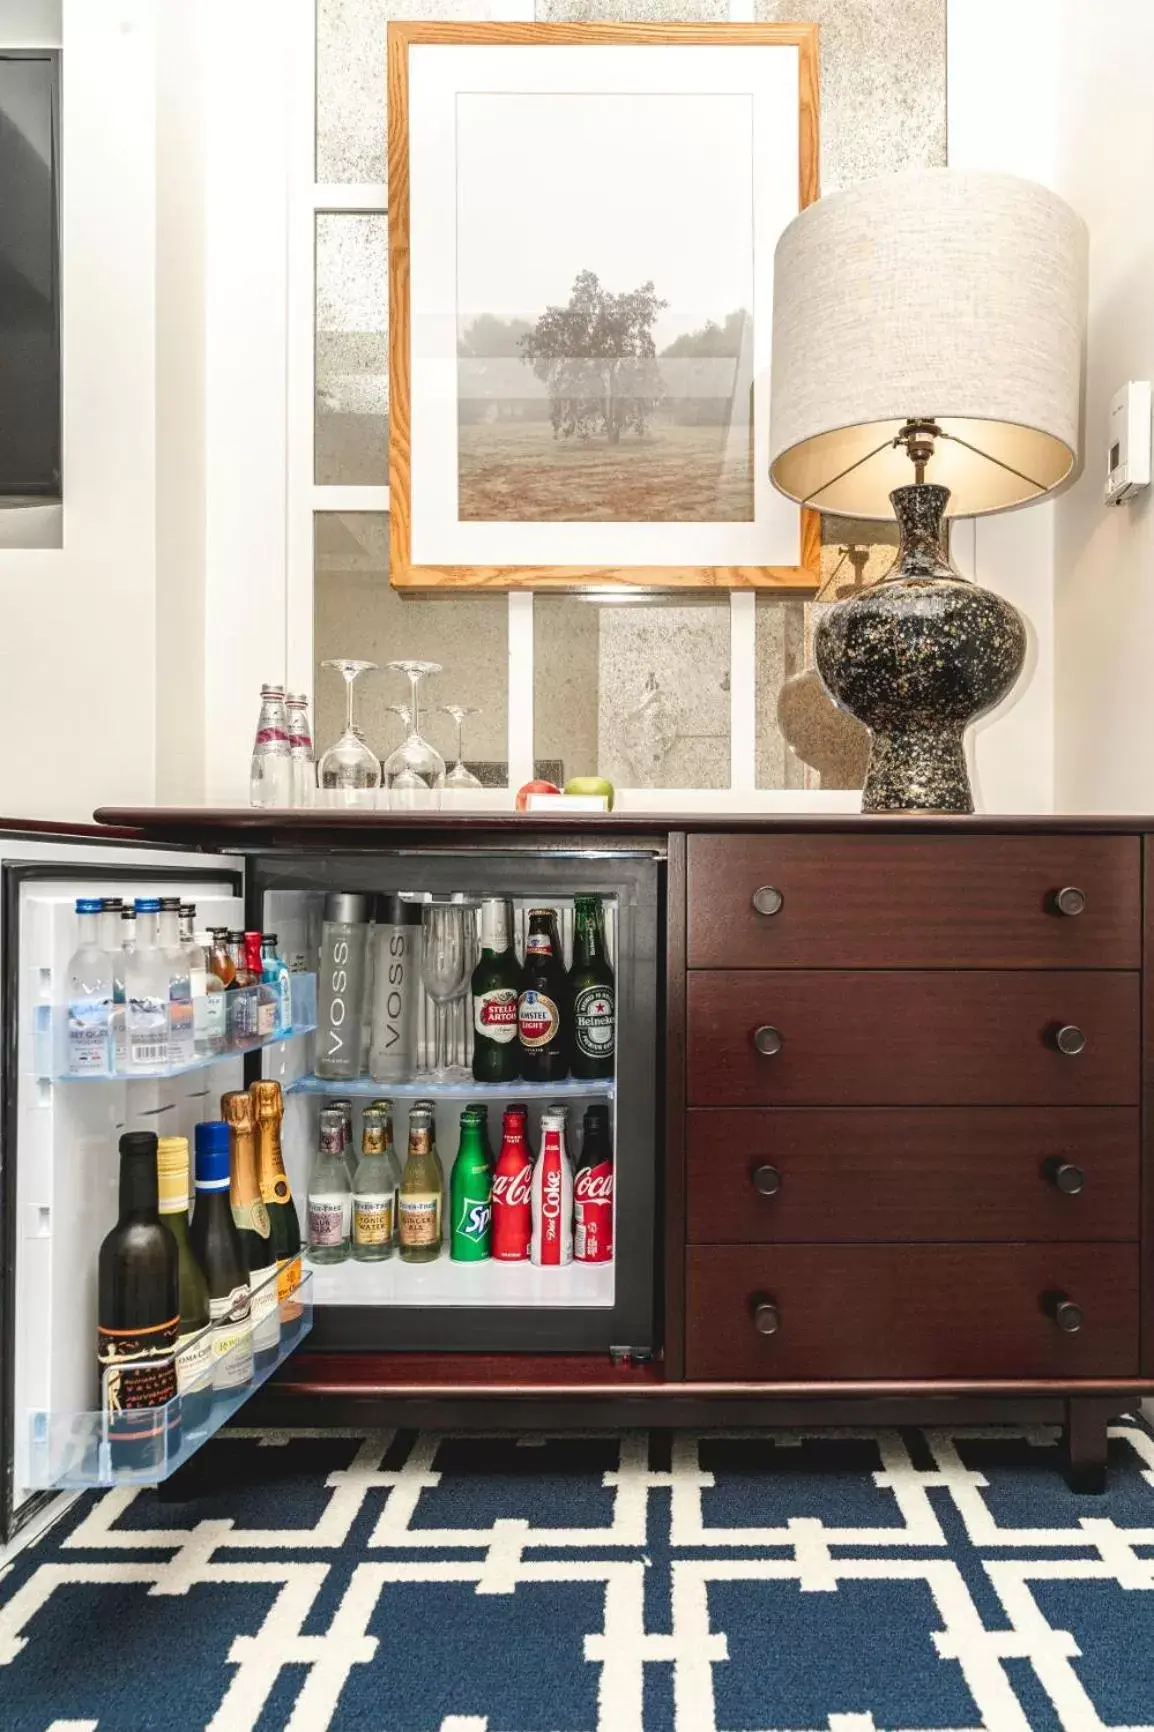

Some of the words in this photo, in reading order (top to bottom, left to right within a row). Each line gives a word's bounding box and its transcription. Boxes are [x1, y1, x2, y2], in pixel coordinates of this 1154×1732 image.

[328, 942, 349, 1055] VOSS
[385, 934, 405, 1048] VOSS
[488, 1013, 516, 1021] ARTOI
[521, 1021, 544, 1030] LIGHT
[578, 1016, 615, 1026] Heineke
[543, 1171, 561, 1218] Coke
[575, 1166, 613, 1197] Coca
